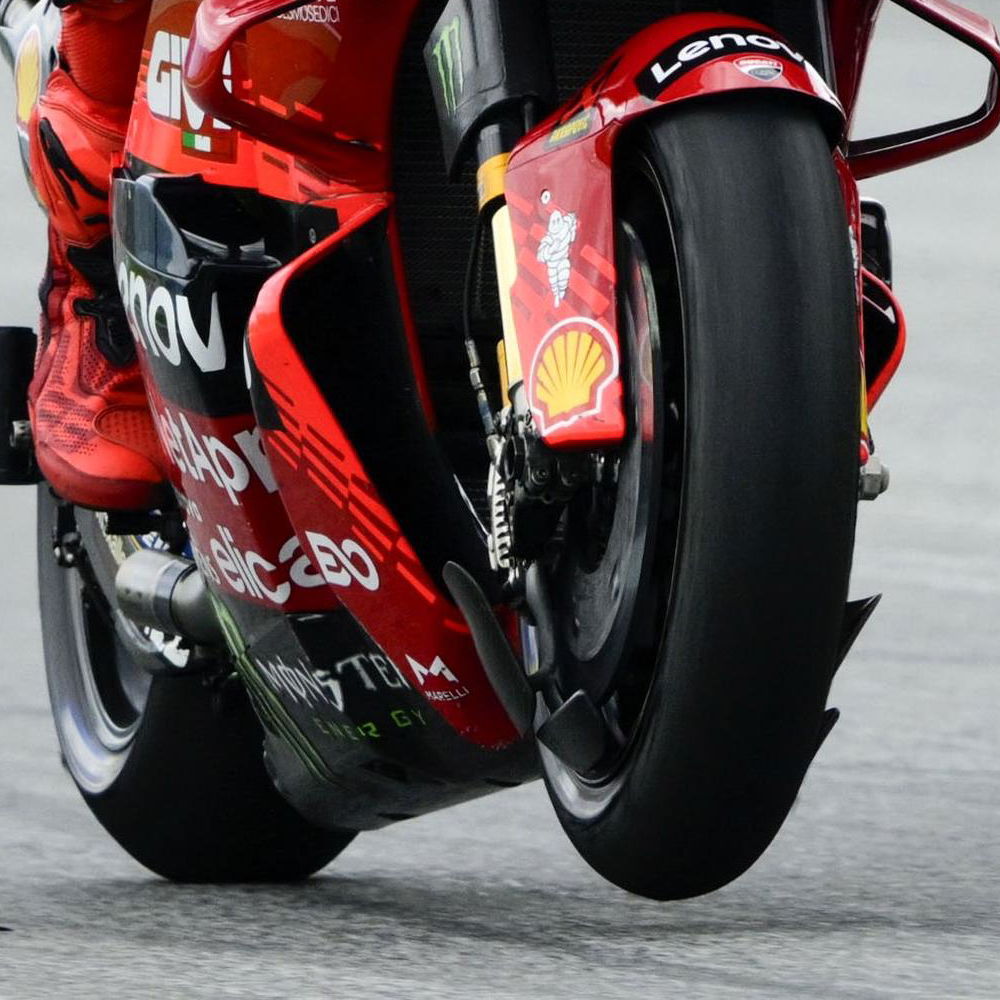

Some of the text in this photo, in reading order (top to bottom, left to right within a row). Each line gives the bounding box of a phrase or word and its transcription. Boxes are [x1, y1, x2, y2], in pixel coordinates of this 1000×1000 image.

[651, 33, 803, 84] Lenov
[118, 262, 238, 380] enov
[426, 686, 469, 701] MARELLI
